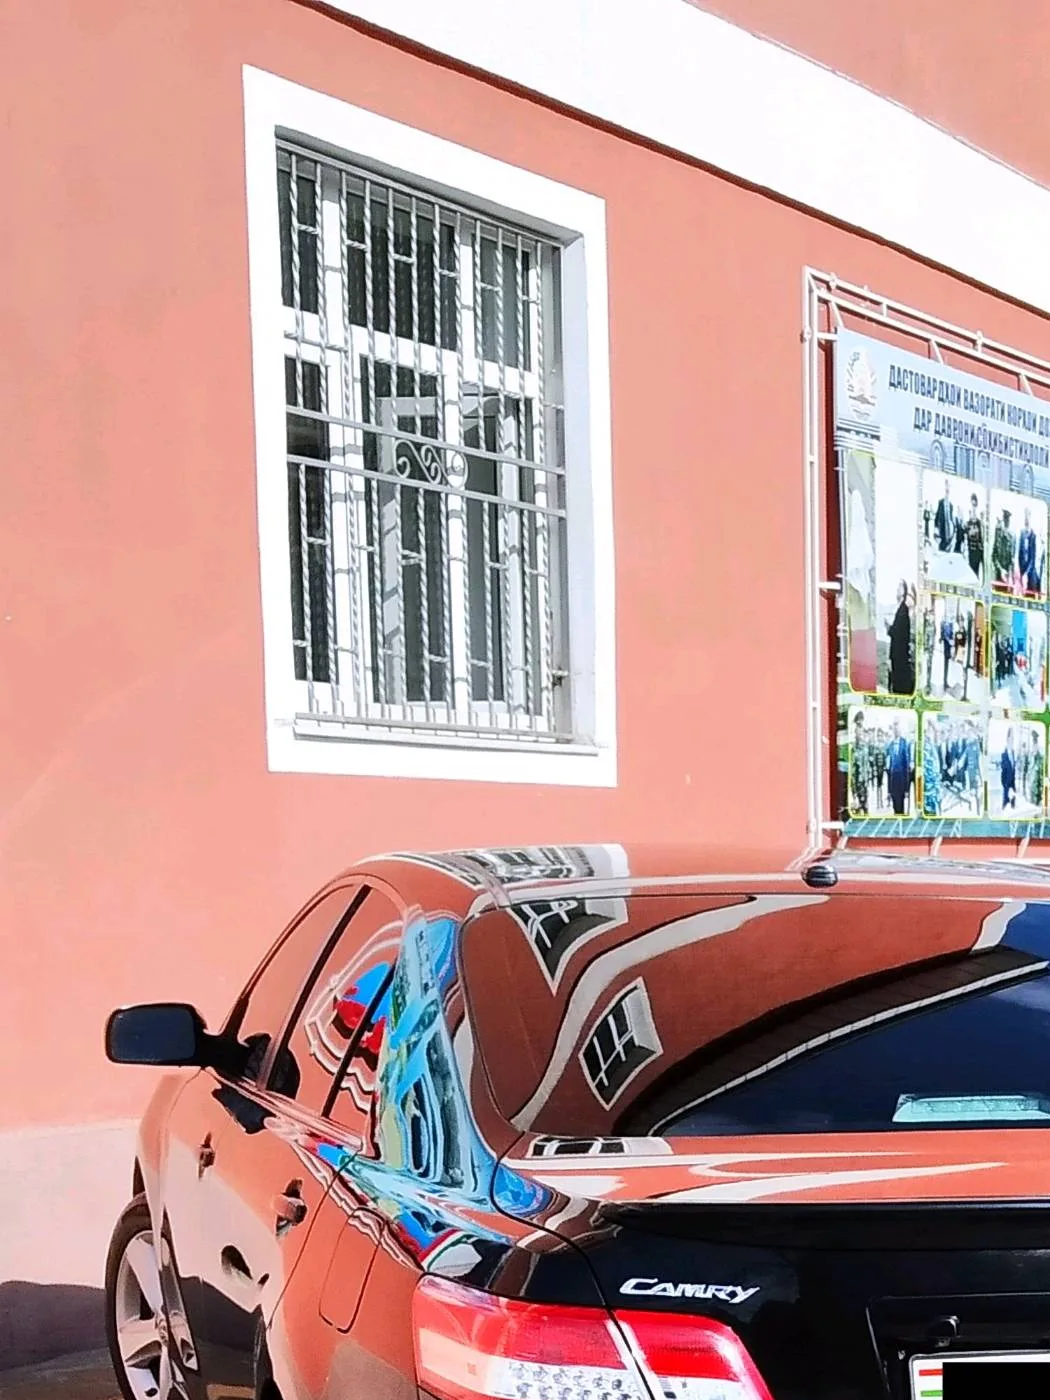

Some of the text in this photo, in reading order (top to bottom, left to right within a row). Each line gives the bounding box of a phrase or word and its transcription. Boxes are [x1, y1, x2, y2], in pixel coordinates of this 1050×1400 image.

[964, 389, 1005, 422] ВАЗОРАТИ
[914, 407, 932, 430] ДАР
[619, 1278, 760, 1303] CAMRY
